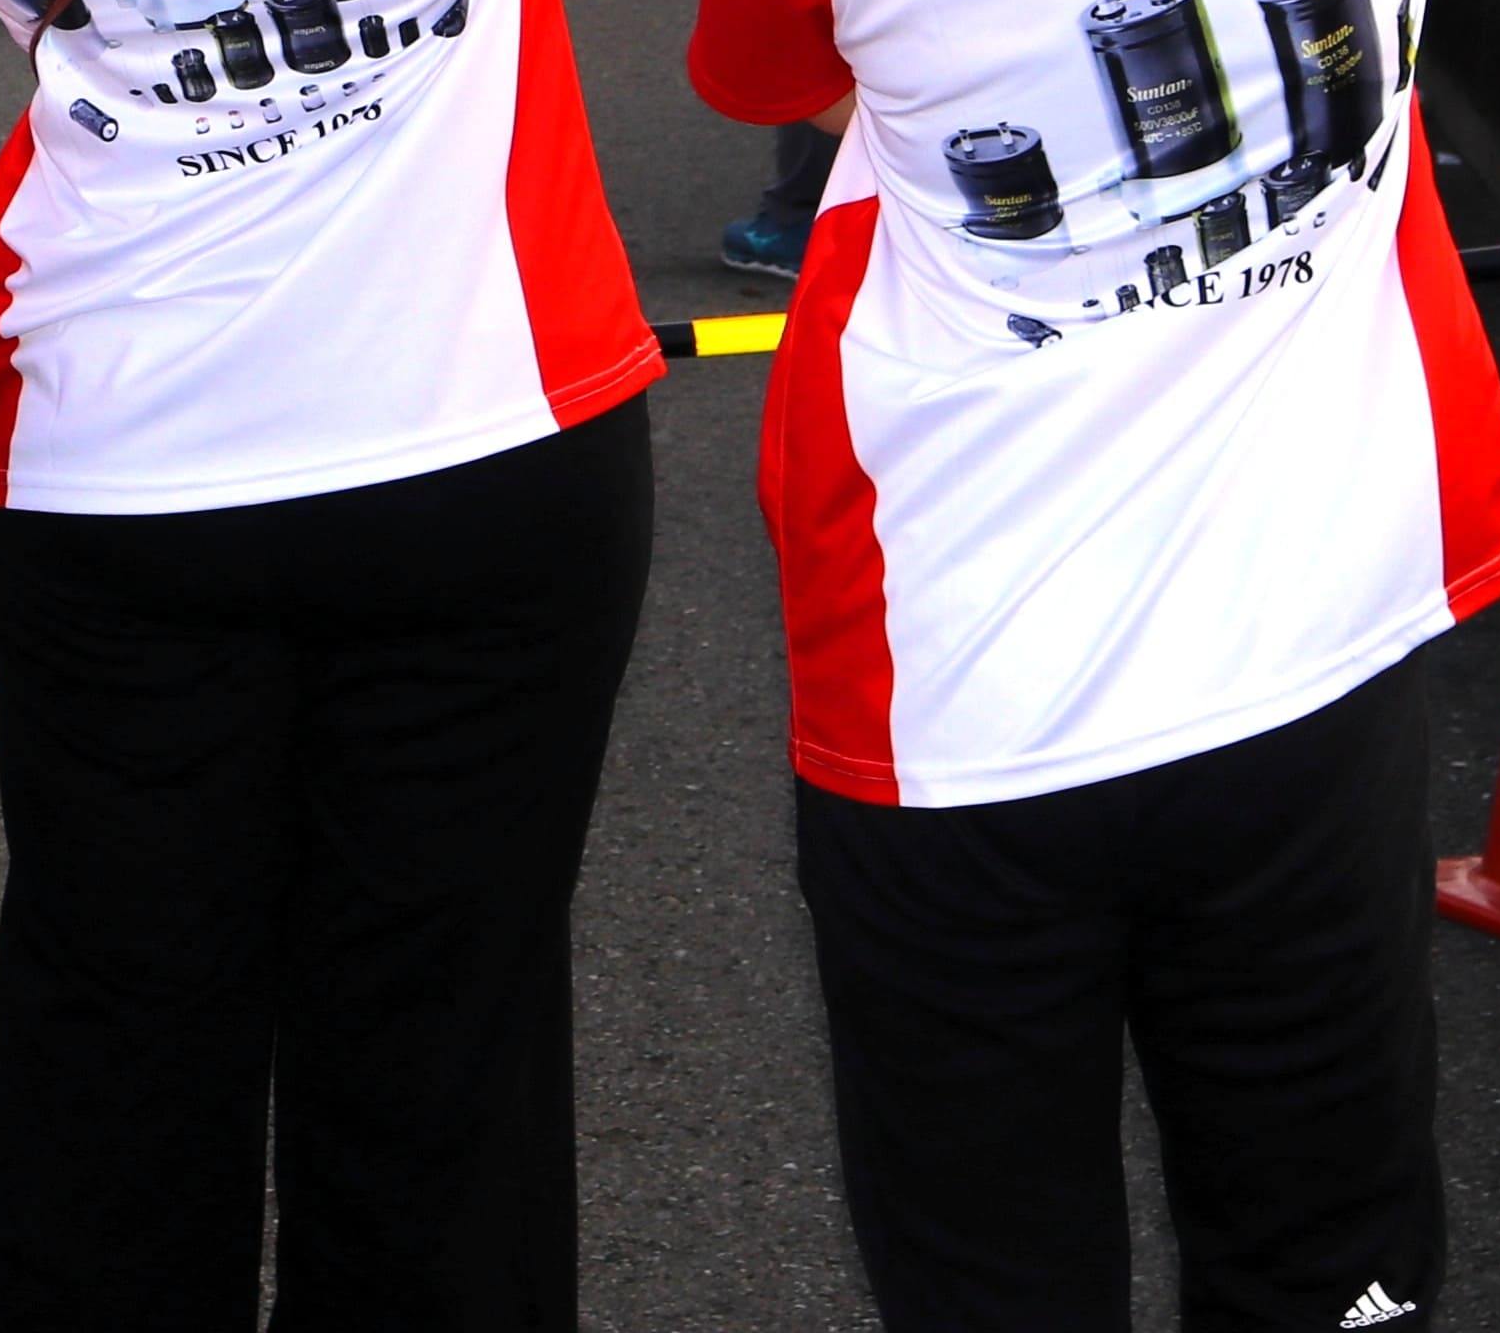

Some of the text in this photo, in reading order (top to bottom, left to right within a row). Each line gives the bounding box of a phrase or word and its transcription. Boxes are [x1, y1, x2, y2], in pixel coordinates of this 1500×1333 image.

[1300, 23, 1355, 59] Suntan
[1126, 78, 1192, 103] Suntan
[176, 129, 302, 177] SINCE
[1238, 250, 1314, 300] 1978
[1339, 1300, 1417, 1330] adidas
